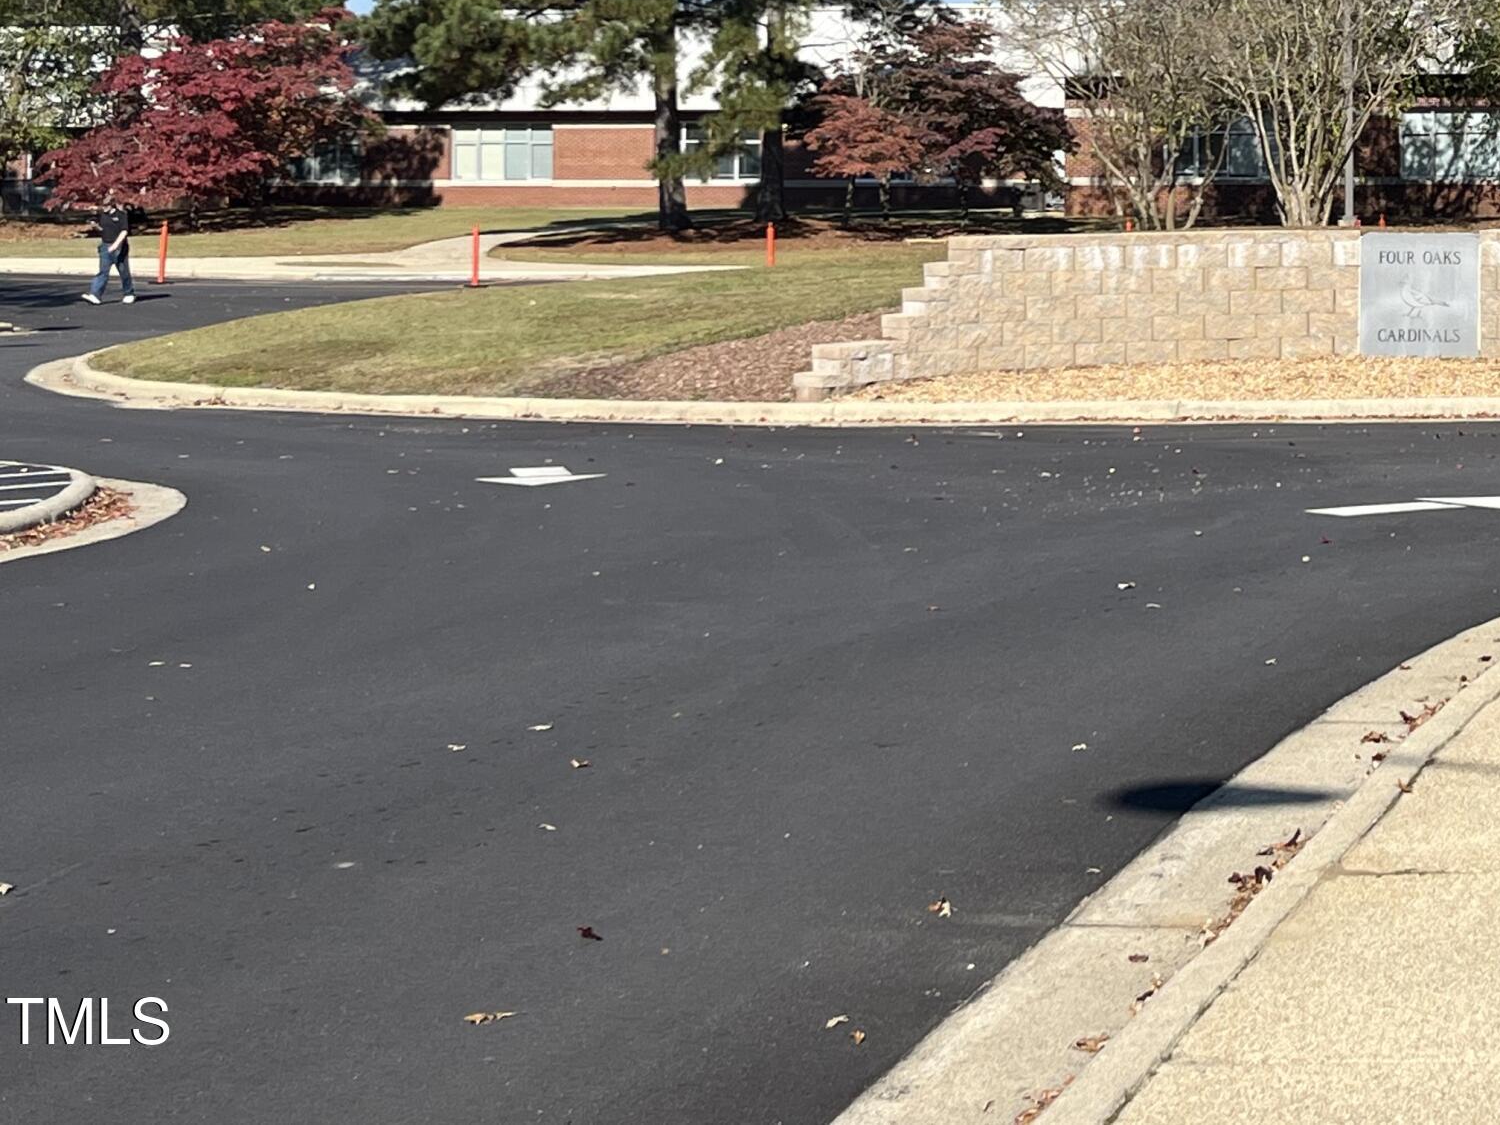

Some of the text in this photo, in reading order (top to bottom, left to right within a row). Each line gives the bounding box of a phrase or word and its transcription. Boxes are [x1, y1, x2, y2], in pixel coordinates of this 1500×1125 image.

[1378, 250, 1462, 265] FOUR OAKS
[1377, 328, 1461, 343] CARDINALS
